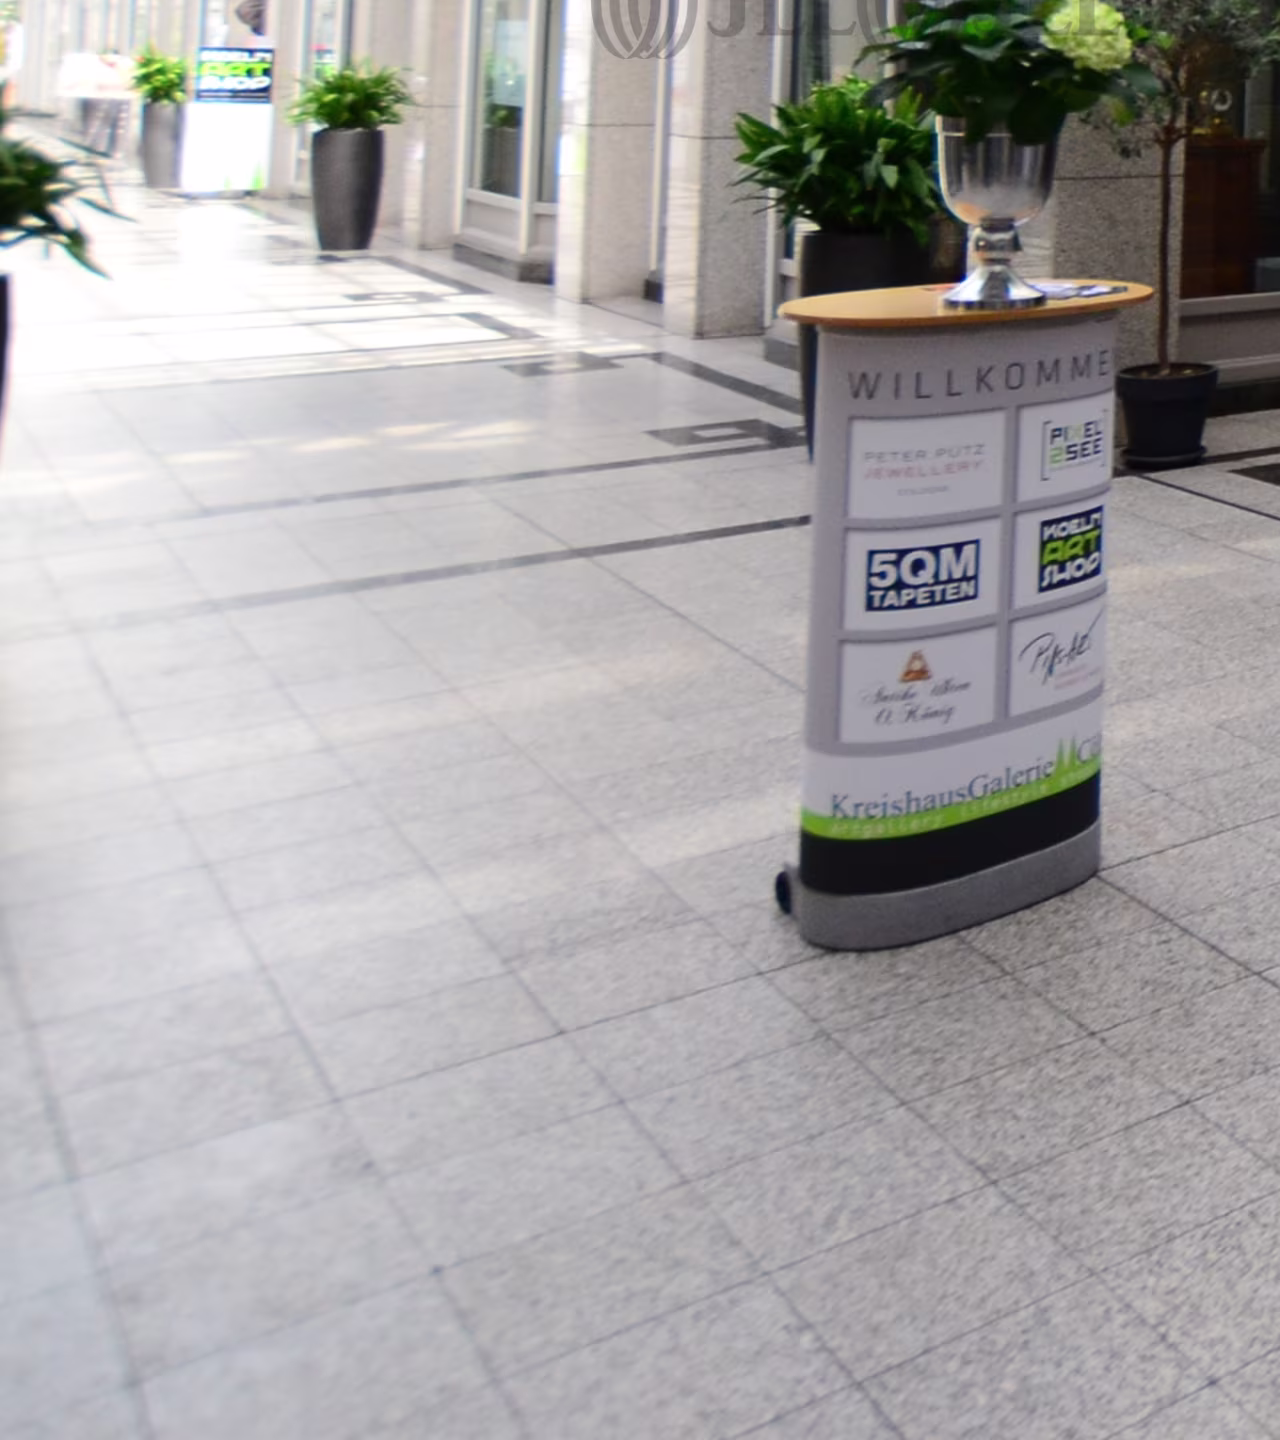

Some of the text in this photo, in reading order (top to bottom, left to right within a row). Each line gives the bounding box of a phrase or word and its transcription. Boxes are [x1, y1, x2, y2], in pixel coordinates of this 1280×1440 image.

[869, 542, 978, 590] 5QM
[1042, 529, 1101, 565] ART
[869, 580, 976, 609] TAPETEN
[830, 756, 1054, 819] KreishausGalerie
